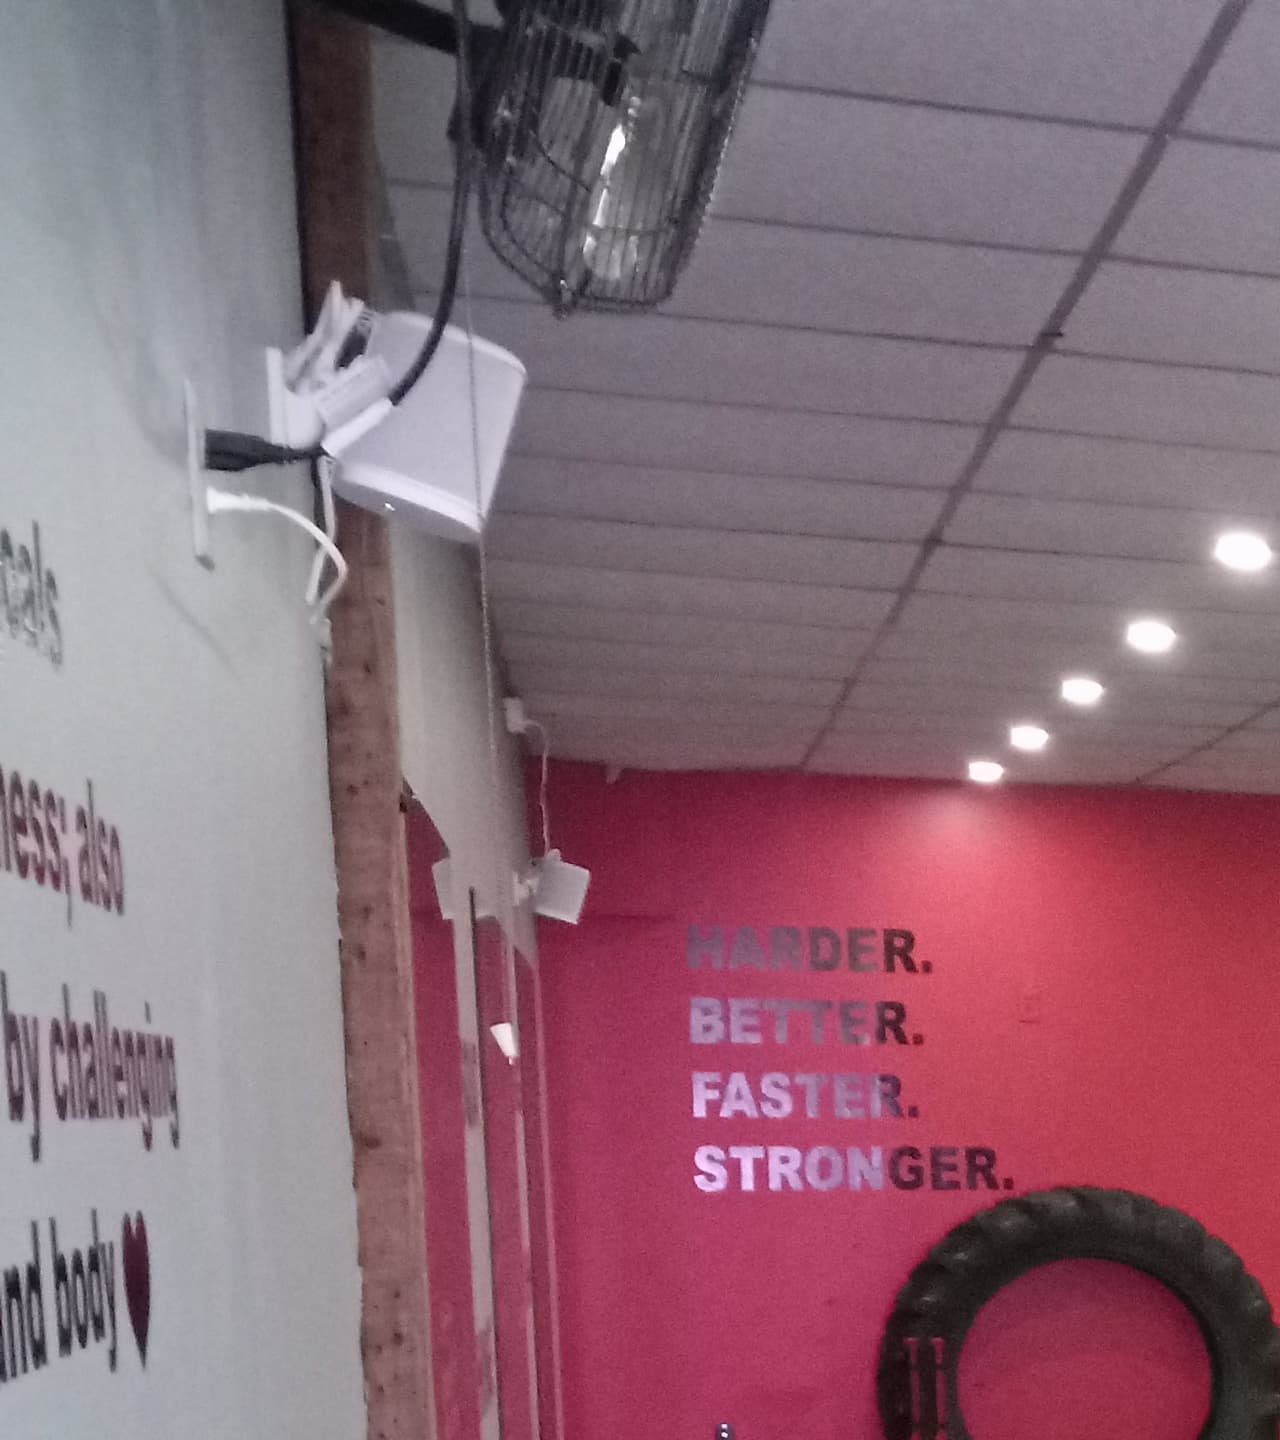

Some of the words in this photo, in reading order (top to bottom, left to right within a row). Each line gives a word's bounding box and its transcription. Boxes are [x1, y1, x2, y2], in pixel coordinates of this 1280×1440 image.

[75, 778, 125, 916] also
[687, 924, 933, 974] HARDER.
[689, 997, 924, 1046] BETTER.
[0, 969, 41, 1162] by
[49, 982, 180, 1150] challenging
[691, 1072, 919, 1119] FASTER.
[693, 1145, 1014, 1193] STRONGER.
[48, 1207, 118, 1374] body
